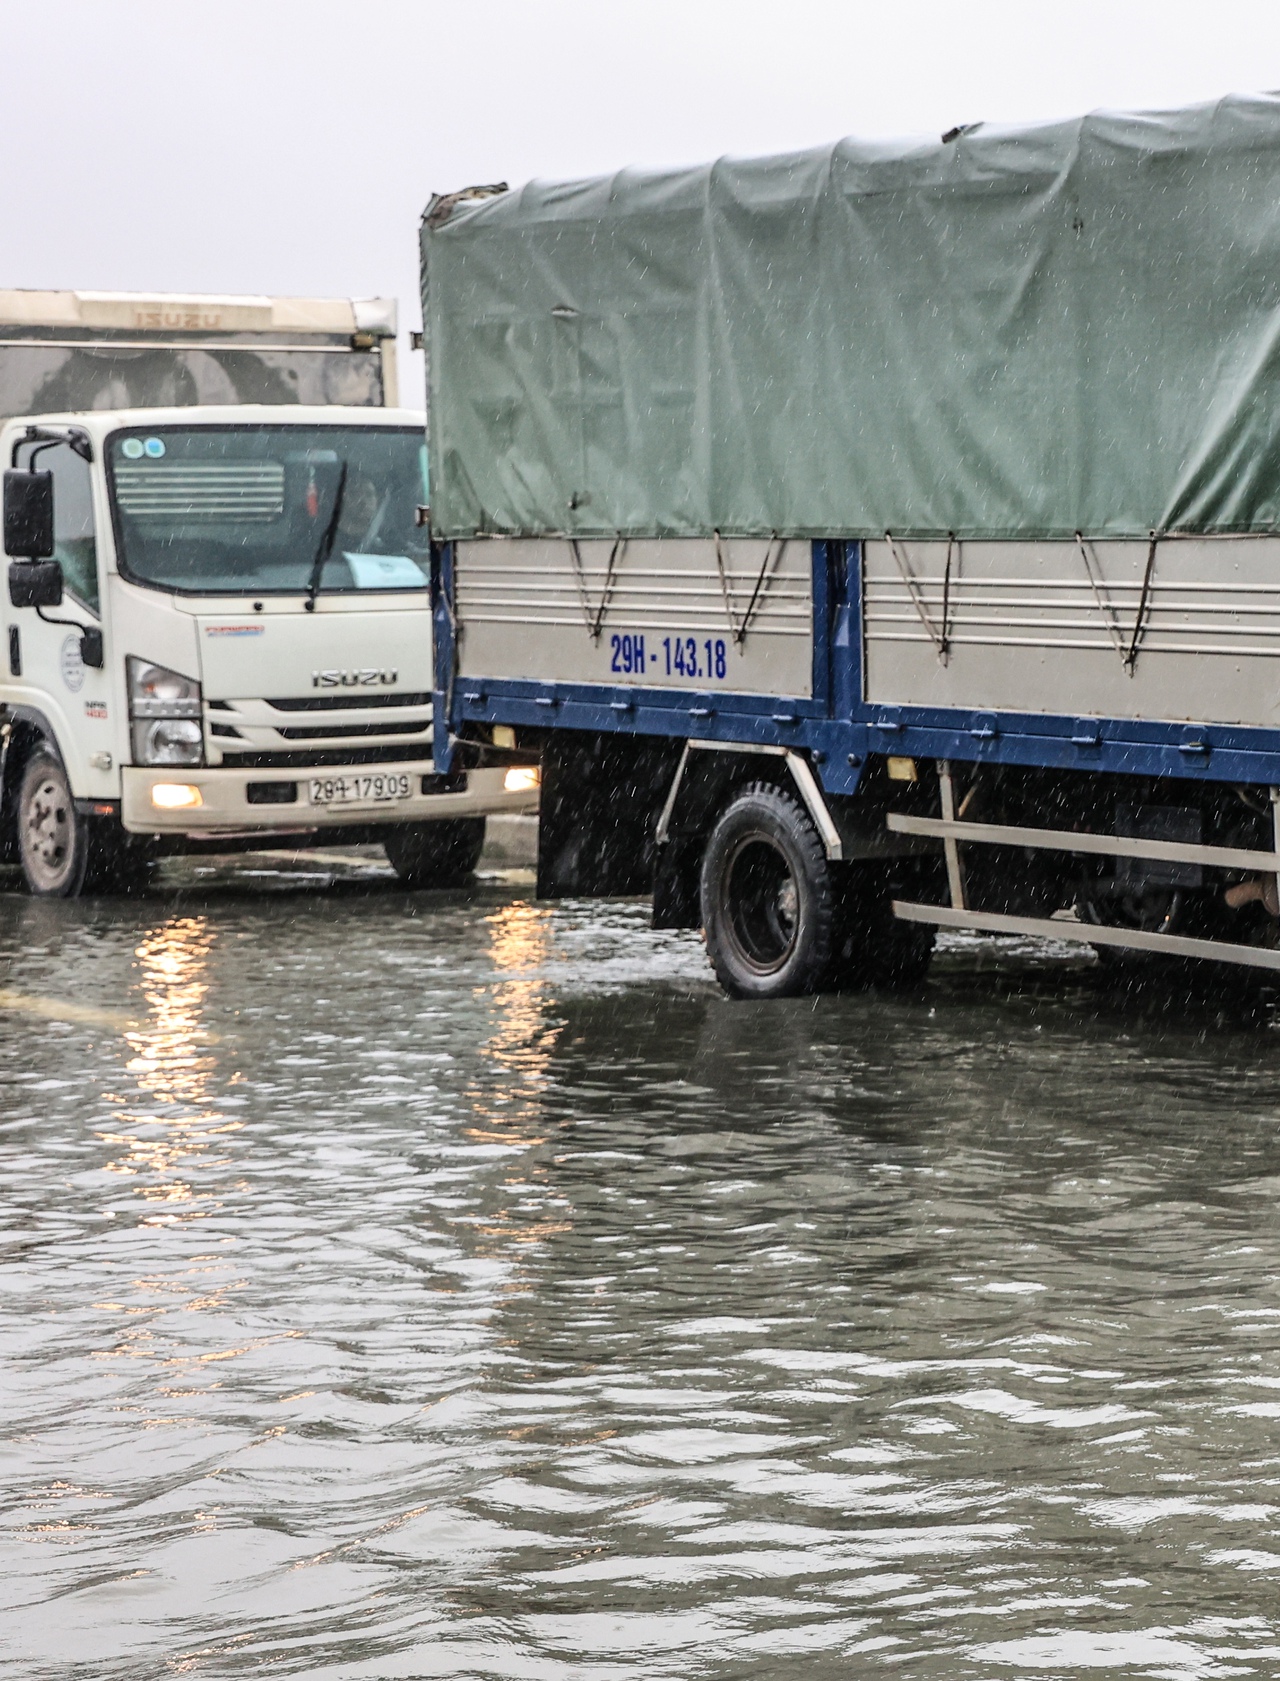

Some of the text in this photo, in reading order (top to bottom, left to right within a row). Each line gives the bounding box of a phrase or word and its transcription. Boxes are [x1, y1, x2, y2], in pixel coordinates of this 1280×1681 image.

[611, 634, 645, 674] 29H
[662, 636, 727, 679] 143.18
[311, 668, 399, 688] ISUZU
